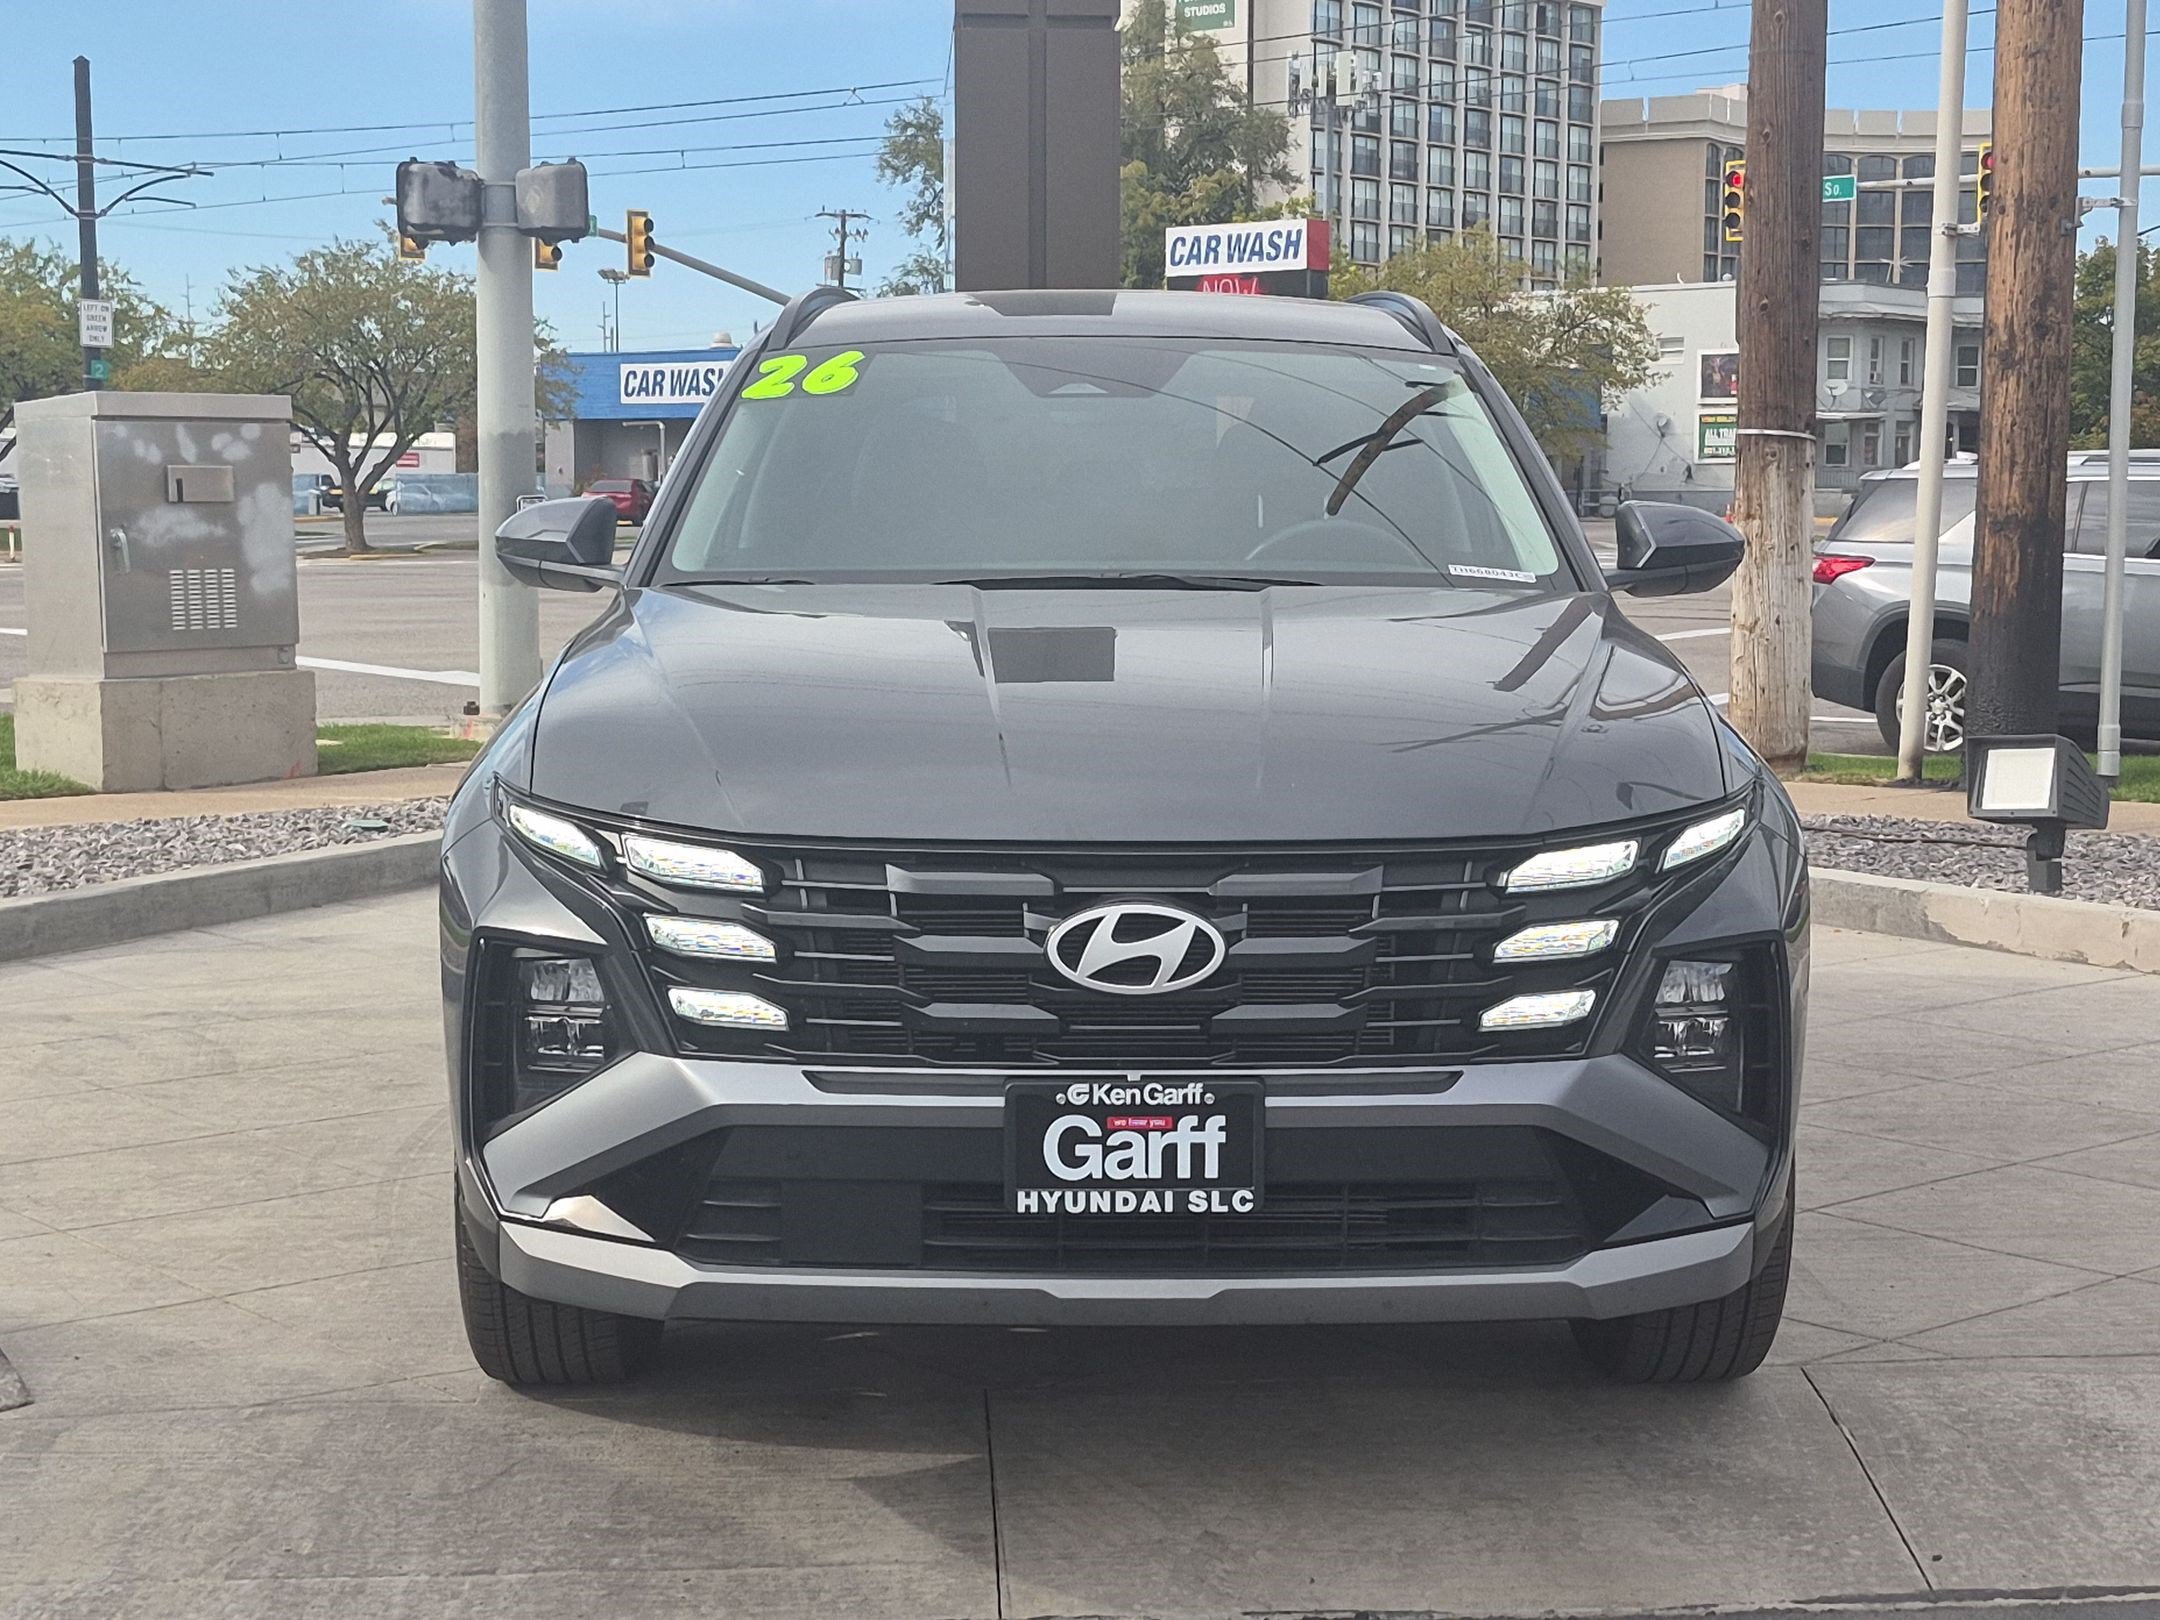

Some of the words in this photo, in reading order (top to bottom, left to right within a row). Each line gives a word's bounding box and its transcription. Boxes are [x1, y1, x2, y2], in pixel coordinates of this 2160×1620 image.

[1184, 3, 1226, 17] STUDIOS
[1170, 233, 1221, 267] CAR
[1227, 229, 1303, 264] WASH
[624, 369, 666, 398] CAR
[741, 350, 866, 400] 26
[1093, 1083, 1141, 1106] Ken
[1143, 1083, 1203, 1106] Garff
[1043, 1114, 1227, 1181] Garff
[1016, 1190, 1174, 1214] HYUNDAI
[1187, 1189, 1255, 1213] SLC
